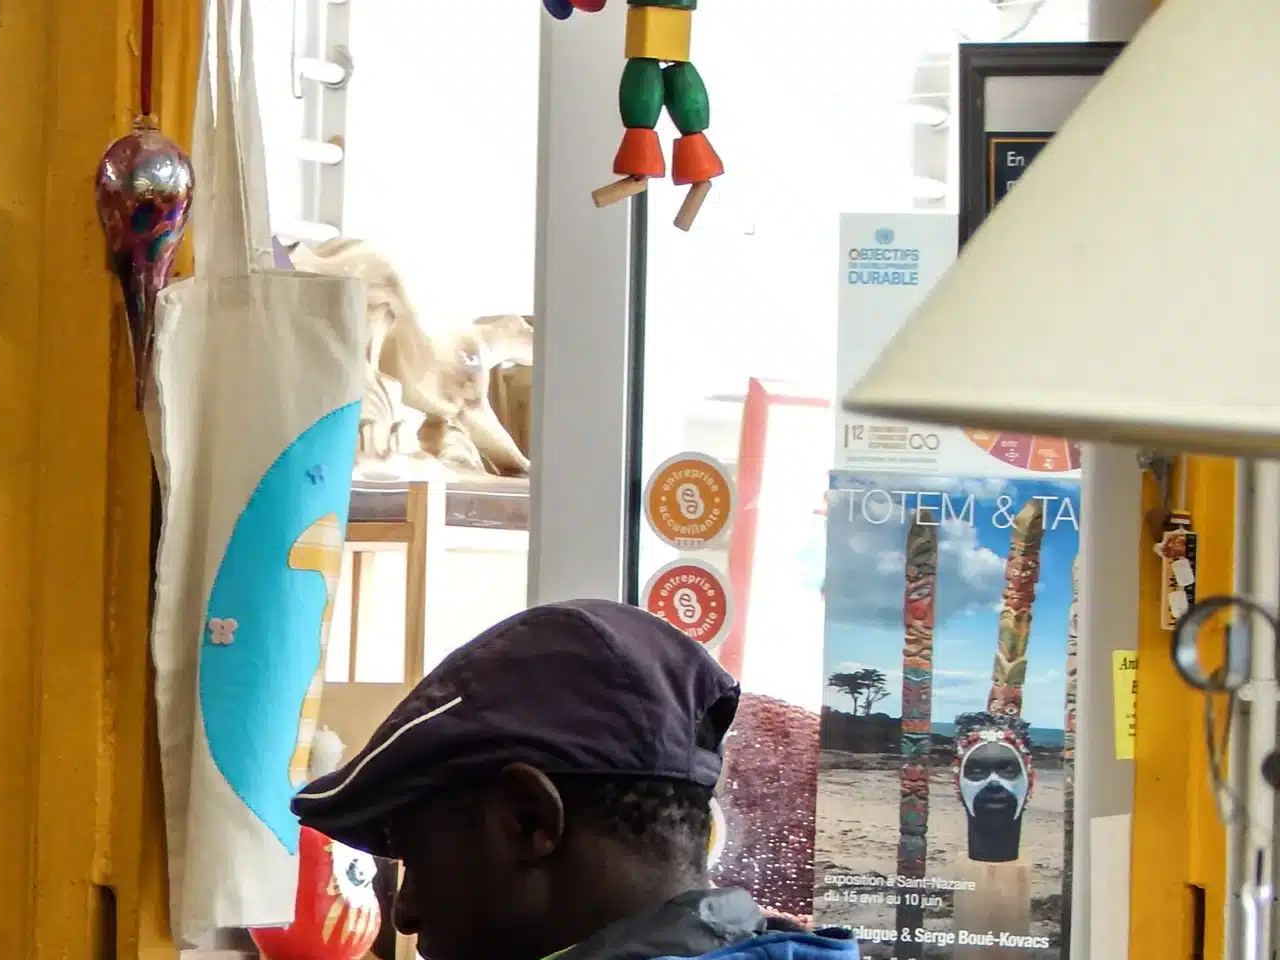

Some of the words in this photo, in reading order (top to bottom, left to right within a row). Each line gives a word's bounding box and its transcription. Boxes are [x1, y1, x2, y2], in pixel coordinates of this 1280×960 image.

[1007, 151, 1025, 167] En
[848, 271, 919, 285] DURABLE
[662, 468, 719, 492] entreprise
[659, 505, 721, 535] accueillante
[840, 488, 974, 528] TOTEM
[992, 495, 1017, 529] &
[1032, 495, 1079, 531] TA
[659, 574, 716, 597] entreprise
[824, 873, 885, 888] exposition
[887, 874, 894, 888] à
[896, 875, 976, 891] Saint-Nazaire
[823, 889, 839, 902] du
[843, 890, 857, 903] 15
[859, 892, 884, 904] avril
[885, 895, 901, 905] au
[905, 893, 919, 906] 10
[920, 894, 943, 909] juin
[900, 928, 913, 942] &
[914, 927, 956, 946] Serge
[958, 929, 1050, 949] Boué-Kovacs
